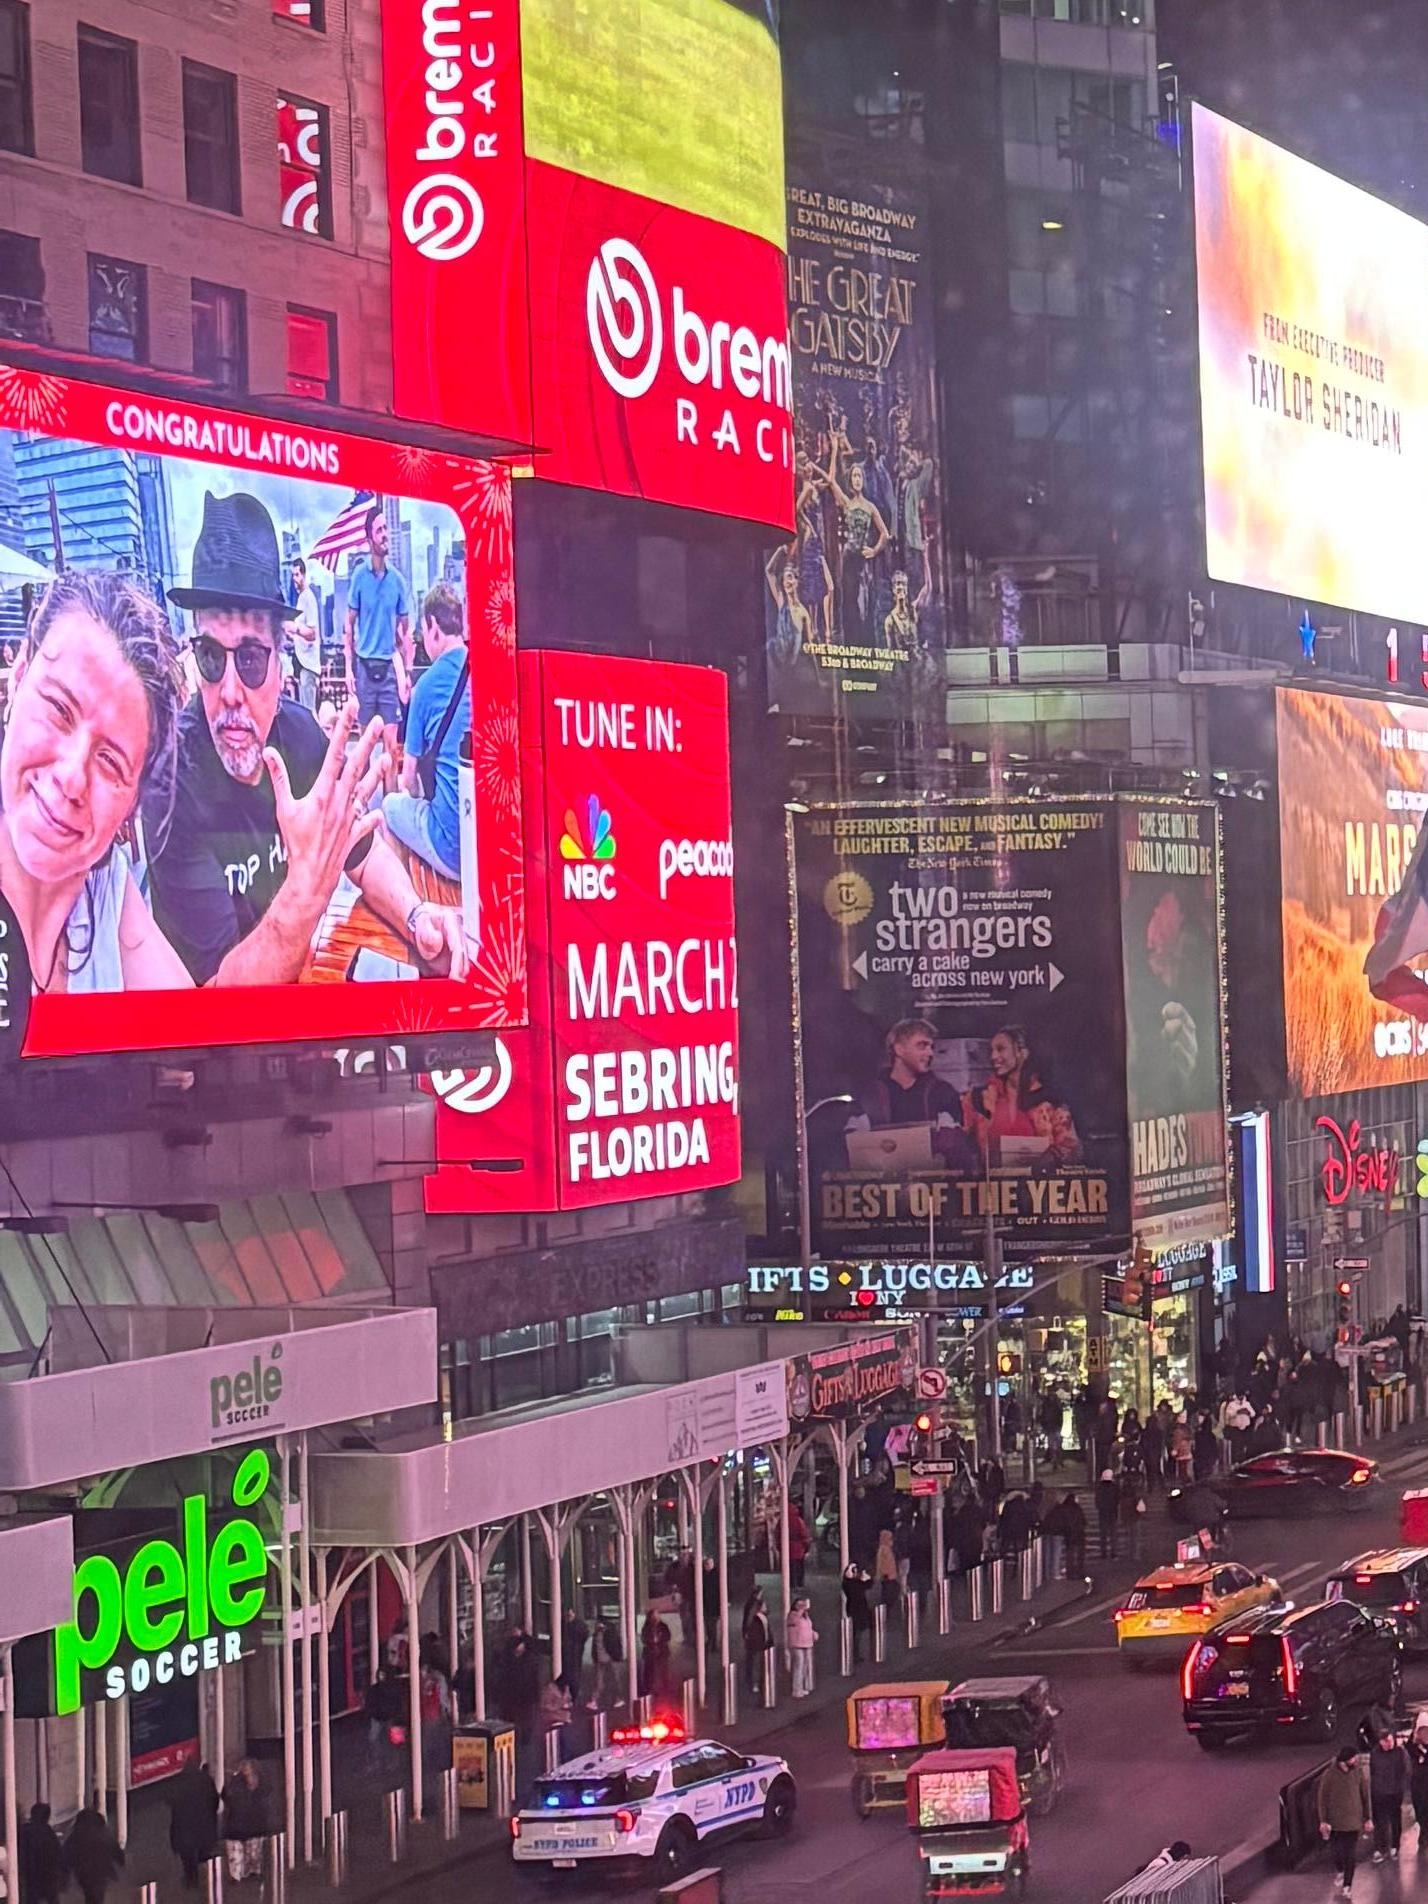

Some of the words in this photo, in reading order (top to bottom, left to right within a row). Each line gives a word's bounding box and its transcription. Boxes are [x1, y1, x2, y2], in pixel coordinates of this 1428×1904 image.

[798, 209, 892, 243] EXTRAVAGANZA
[828, 196, 849, 214] BIG
[852, 201, 916, 230] BROADWAY
[827, 265, 916, 325] GREAT
[674, 285, 793, 402] brem
[791, 308, 900, 368] GATSBY
[1263, 313, 1290, 345] FROM
[1293, 324, 1341, 367] EXECUTIVE
[1343, 341, 1386, 384] PRODUCER
[821, 363, 842, 378] NEW
[1248, 354, 1314, 425] TAYLOR
[1322, 382, 1402, 456] SHERIDAN
[105, 401, 341, 474] CONGRATULATIONS
[678, 399, 795, 463] RACI
[554, 698, 638, 748] TUNE
[645, 704, 684, 753] IN:
[833, 837, 916, 856] LAUGHTER,
[917, 835, 978, 854] ESCAPE,
[997, 832, 1077, 851] FANTASY."
[834, 817, 936, 836] EFFERVESCENT
[939, 817, 971, 834] NEW
[974, 814, 1037, 832] MUSICAL
[1039, 812, 1104, 831] COMEDY!
[224, 850, 260, 895] TOP
[1127, 840, 1163, 873] WORLD
[1165, 842, 1198, 874] COULD
[1199, 846, 1212, 875] BE
[564, 865, 618, 901] NBC
[888, 881, 958, 919] two
[876, 915, 1053, 958] strangers
[568, 940, 724, 1021] MARCH
[872, 954, 914, 976] carry
[918, 956, 928, 971] a
[932, 952, 970, 971] cake
[911, 971, 967, 988] across
[971, 970, 1004, 988] new
[1008, 965, 1045, 991] york
[566, 1045, 738, 1122] SEBRING,
[568, 1120, 709, 1183] FLORIDA
[822, 1183, 901, 1218] BEST
[908, 1183, 949, 1216] OF
[956, 1181, 1019, 1217] THE
[1025, 1179, 1108, 1214] YEAR
[876, 1291, 905, 1306] NY
[225, 1404, 271, 1426] SOCCER
[105, 1631, 243, 1700] SOCCER
[724, 1781, 755, 1809] NYPD
